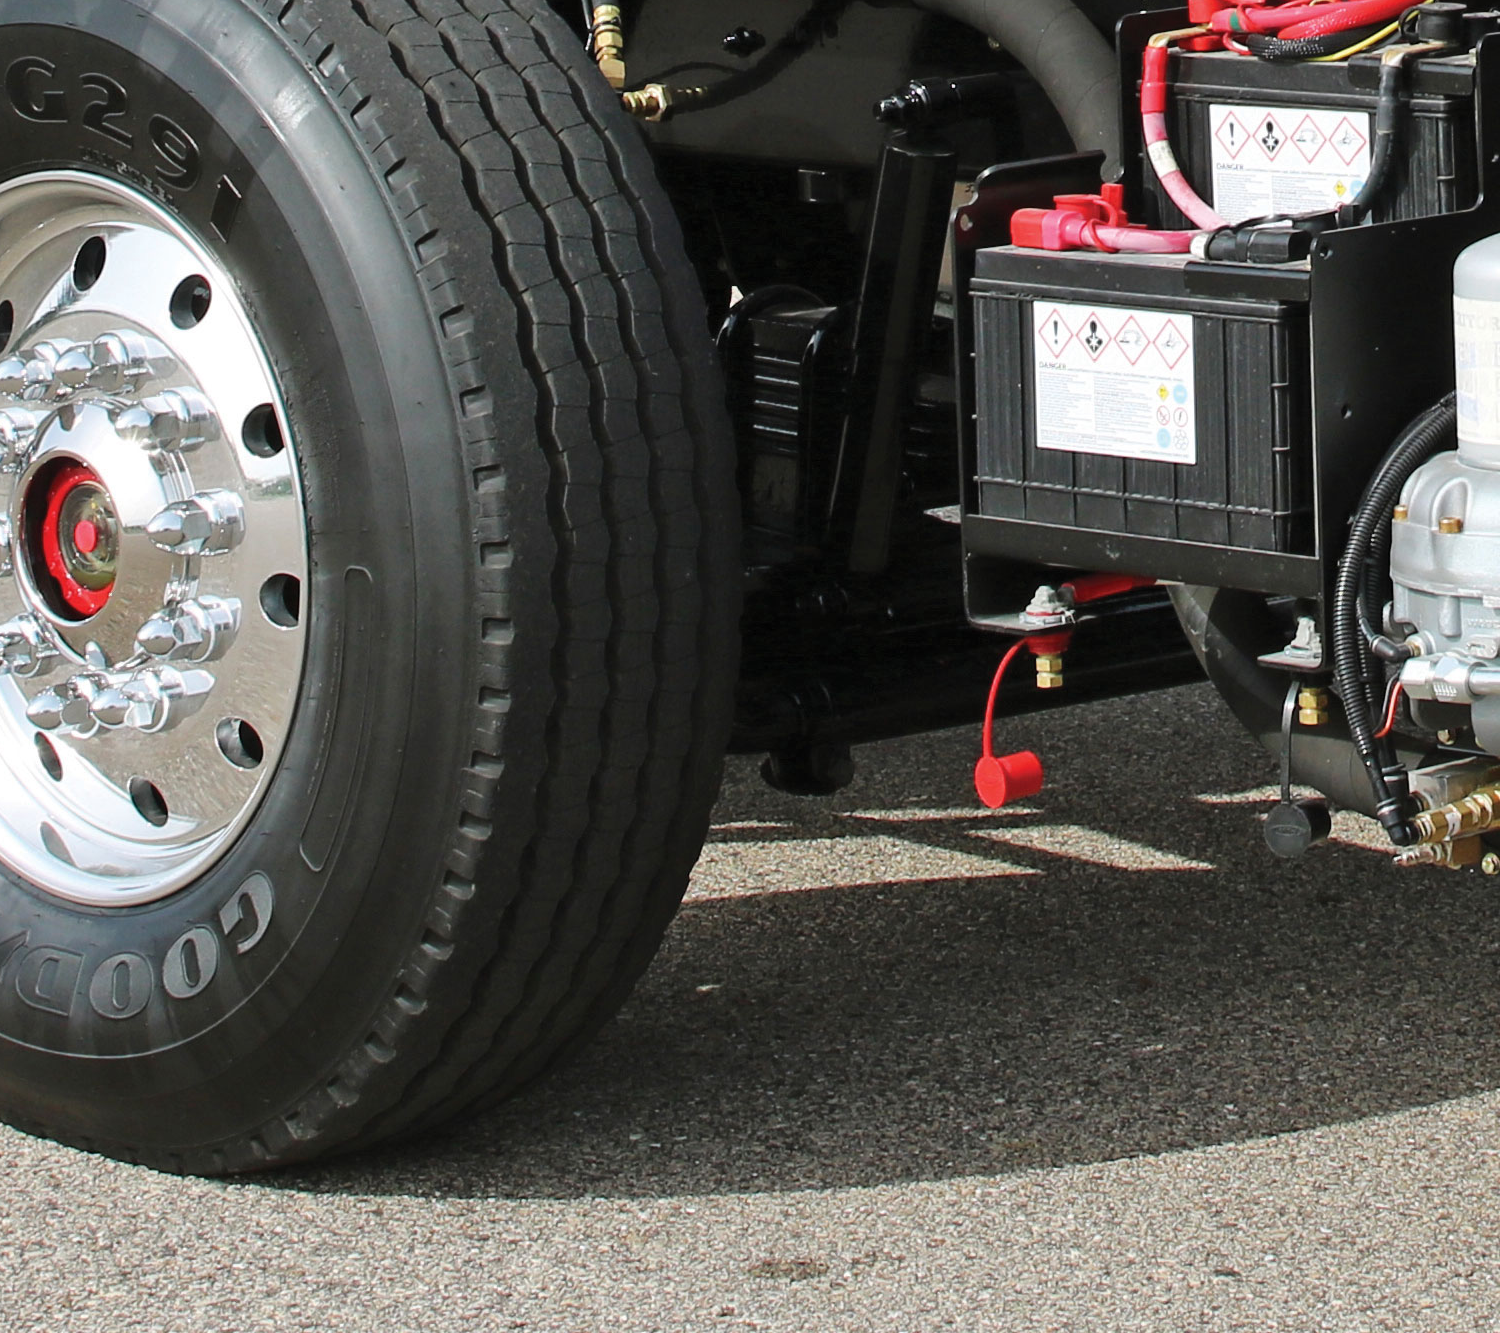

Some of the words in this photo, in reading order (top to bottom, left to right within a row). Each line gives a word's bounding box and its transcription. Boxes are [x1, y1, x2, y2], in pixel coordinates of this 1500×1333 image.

[4, 55, 243, 244] G291
[1216, 162, 1244, 170] DANGER
[1039, 361, 1067, 371] DANGER
